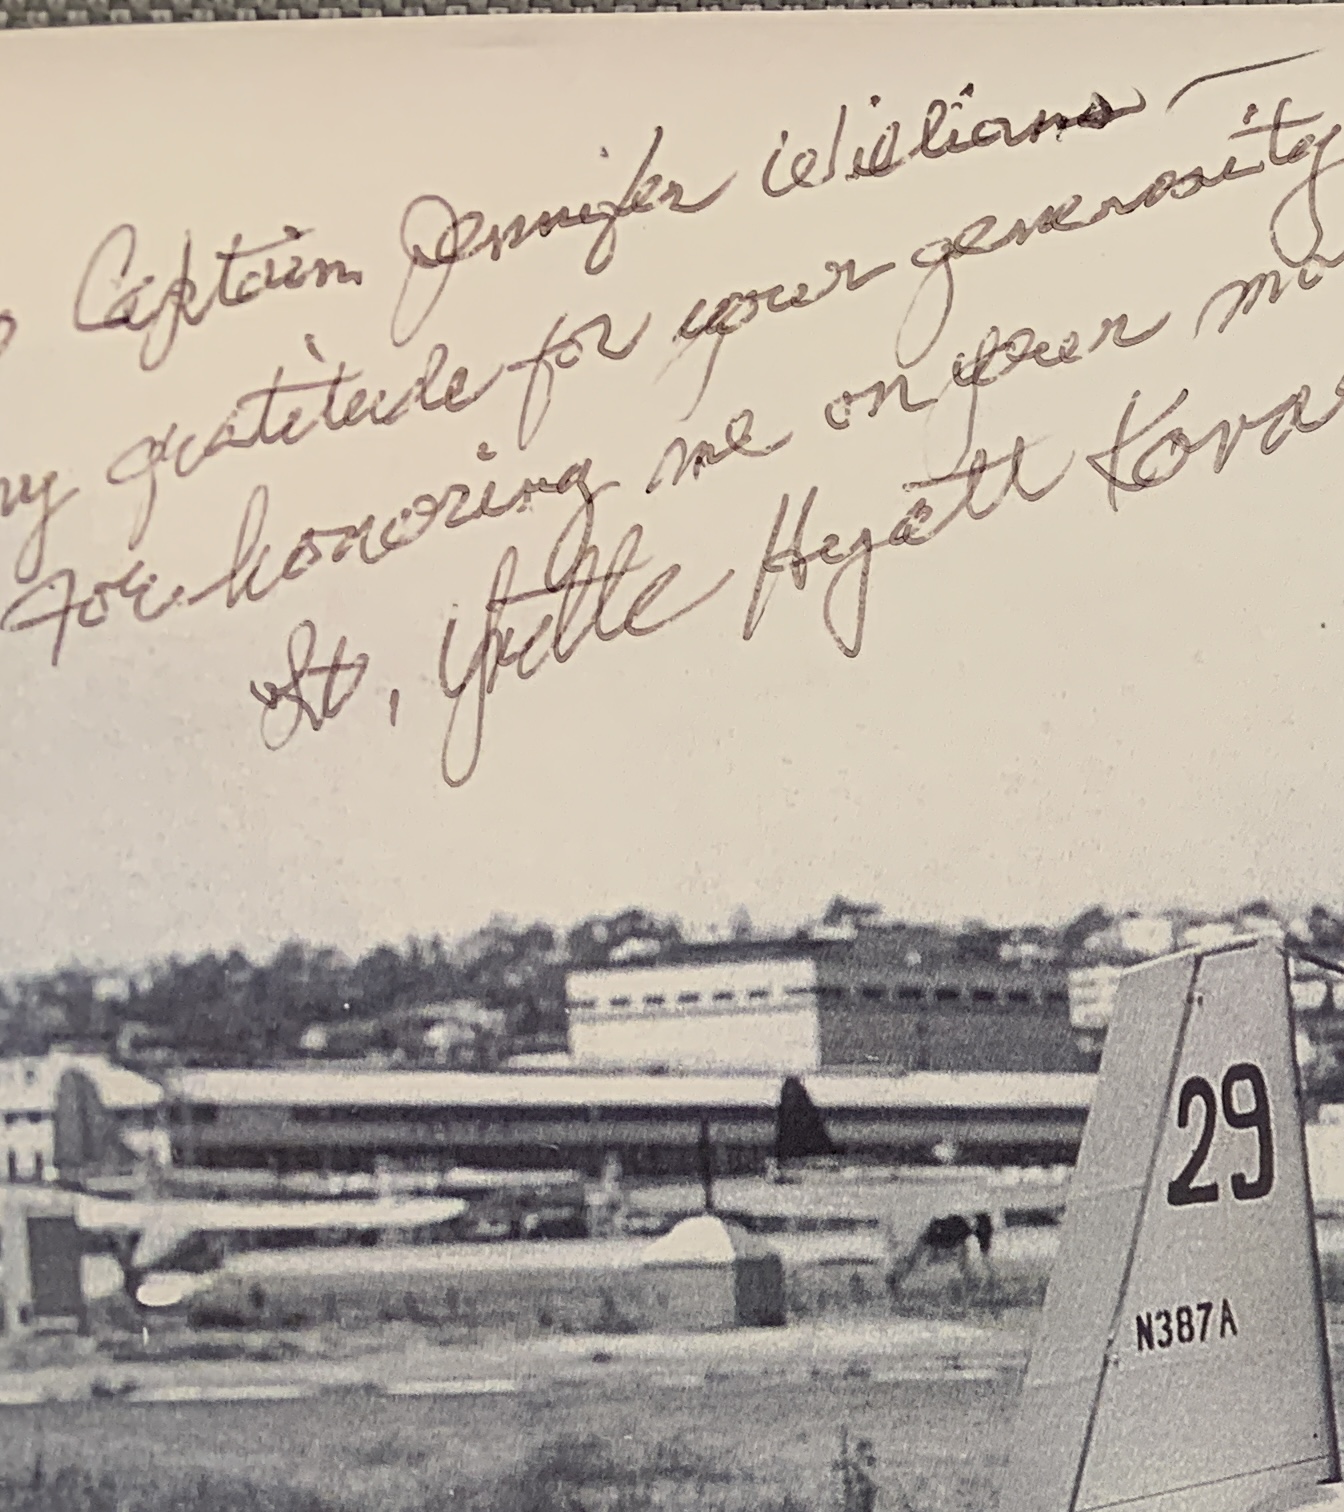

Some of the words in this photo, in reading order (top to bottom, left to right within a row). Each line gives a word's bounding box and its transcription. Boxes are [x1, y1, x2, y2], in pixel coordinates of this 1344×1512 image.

[74, 224, 363, 371] Captain
[391, 126, 738, 347] Jennifer
[761, 84, 1148, 199] Williams
[106, 333, 505, 551] gratitude
[507, 312, 652, 450] for
[653, 258, 896, 421] your
[187, 442, 620, 595] honoring
[646, 409, 793, 495] me
[824, 373, 940, 430] on
[924, 312, 1172, 482] your
[437, 524, 736, 788] Yvette
[741, 434, 1075, 660] Hyatt
[1166, 1061, 1276, 1206] 29
[1134, 1297, 1239, 1352] N387A
